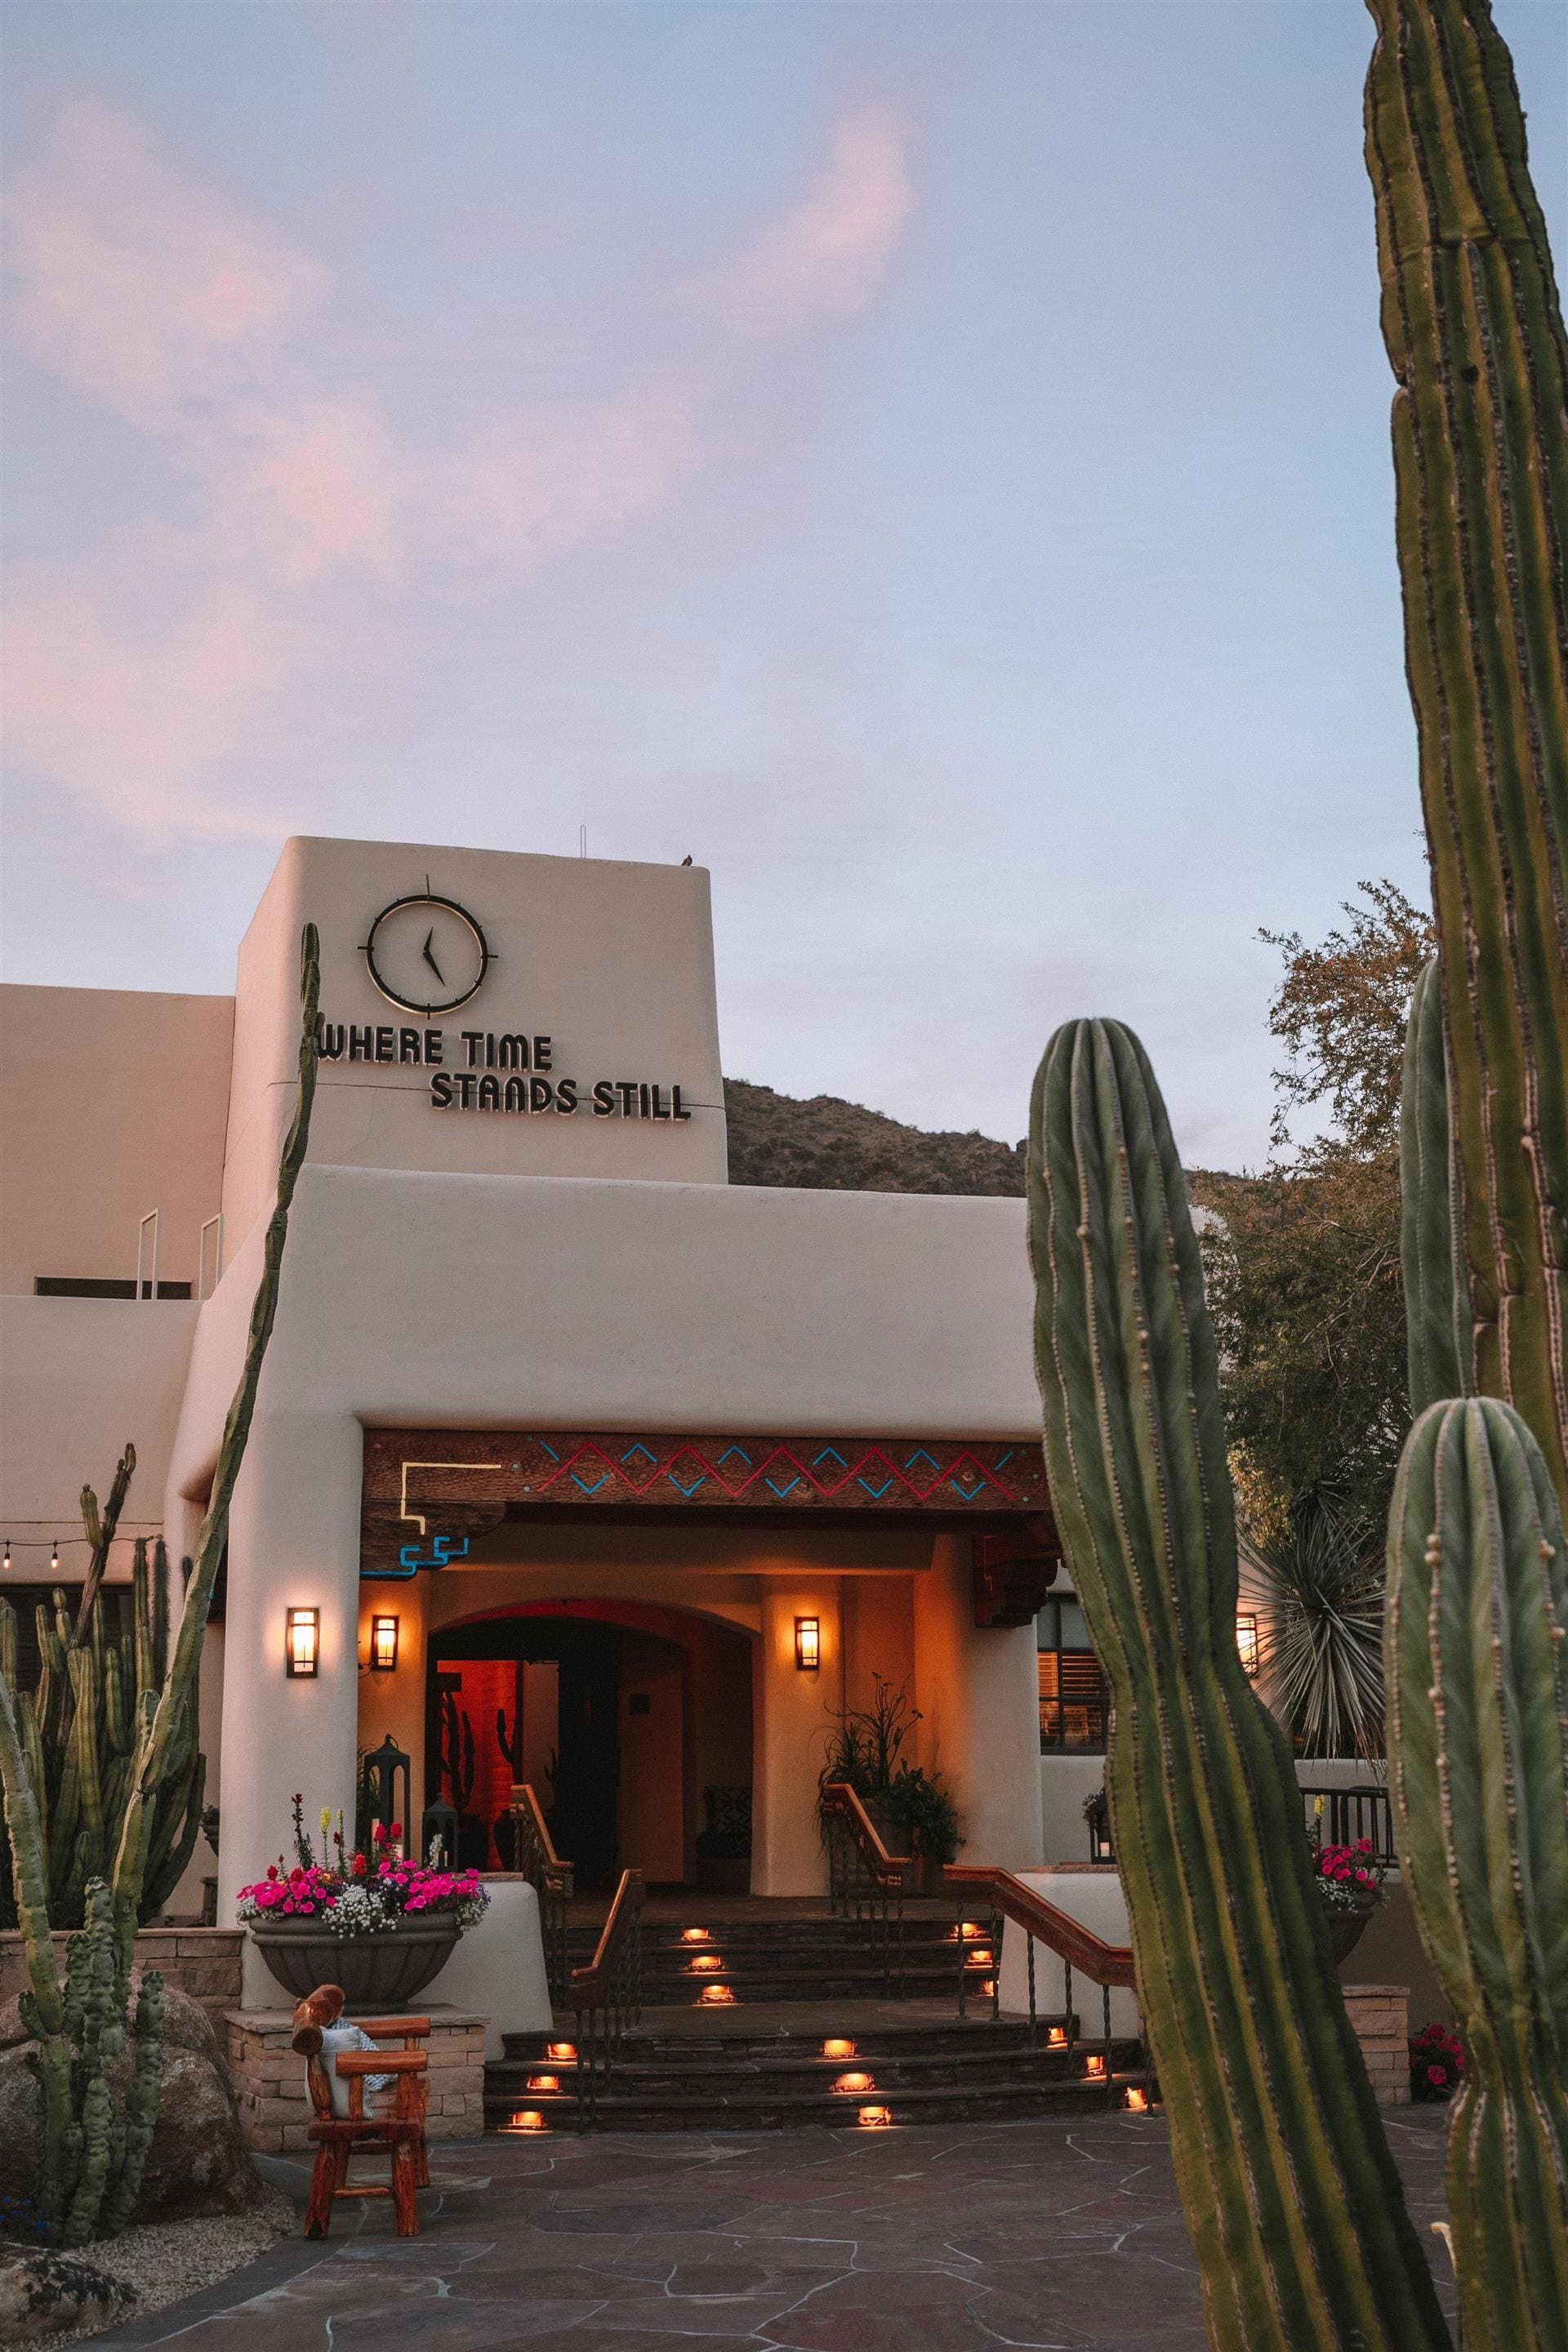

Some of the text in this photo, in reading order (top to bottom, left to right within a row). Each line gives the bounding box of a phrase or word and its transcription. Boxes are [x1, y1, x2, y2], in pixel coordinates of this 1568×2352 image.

[319, 1024, 552, 1071] WHERE TIME
[430, 1072, 692, 1121] STANDS STILL
